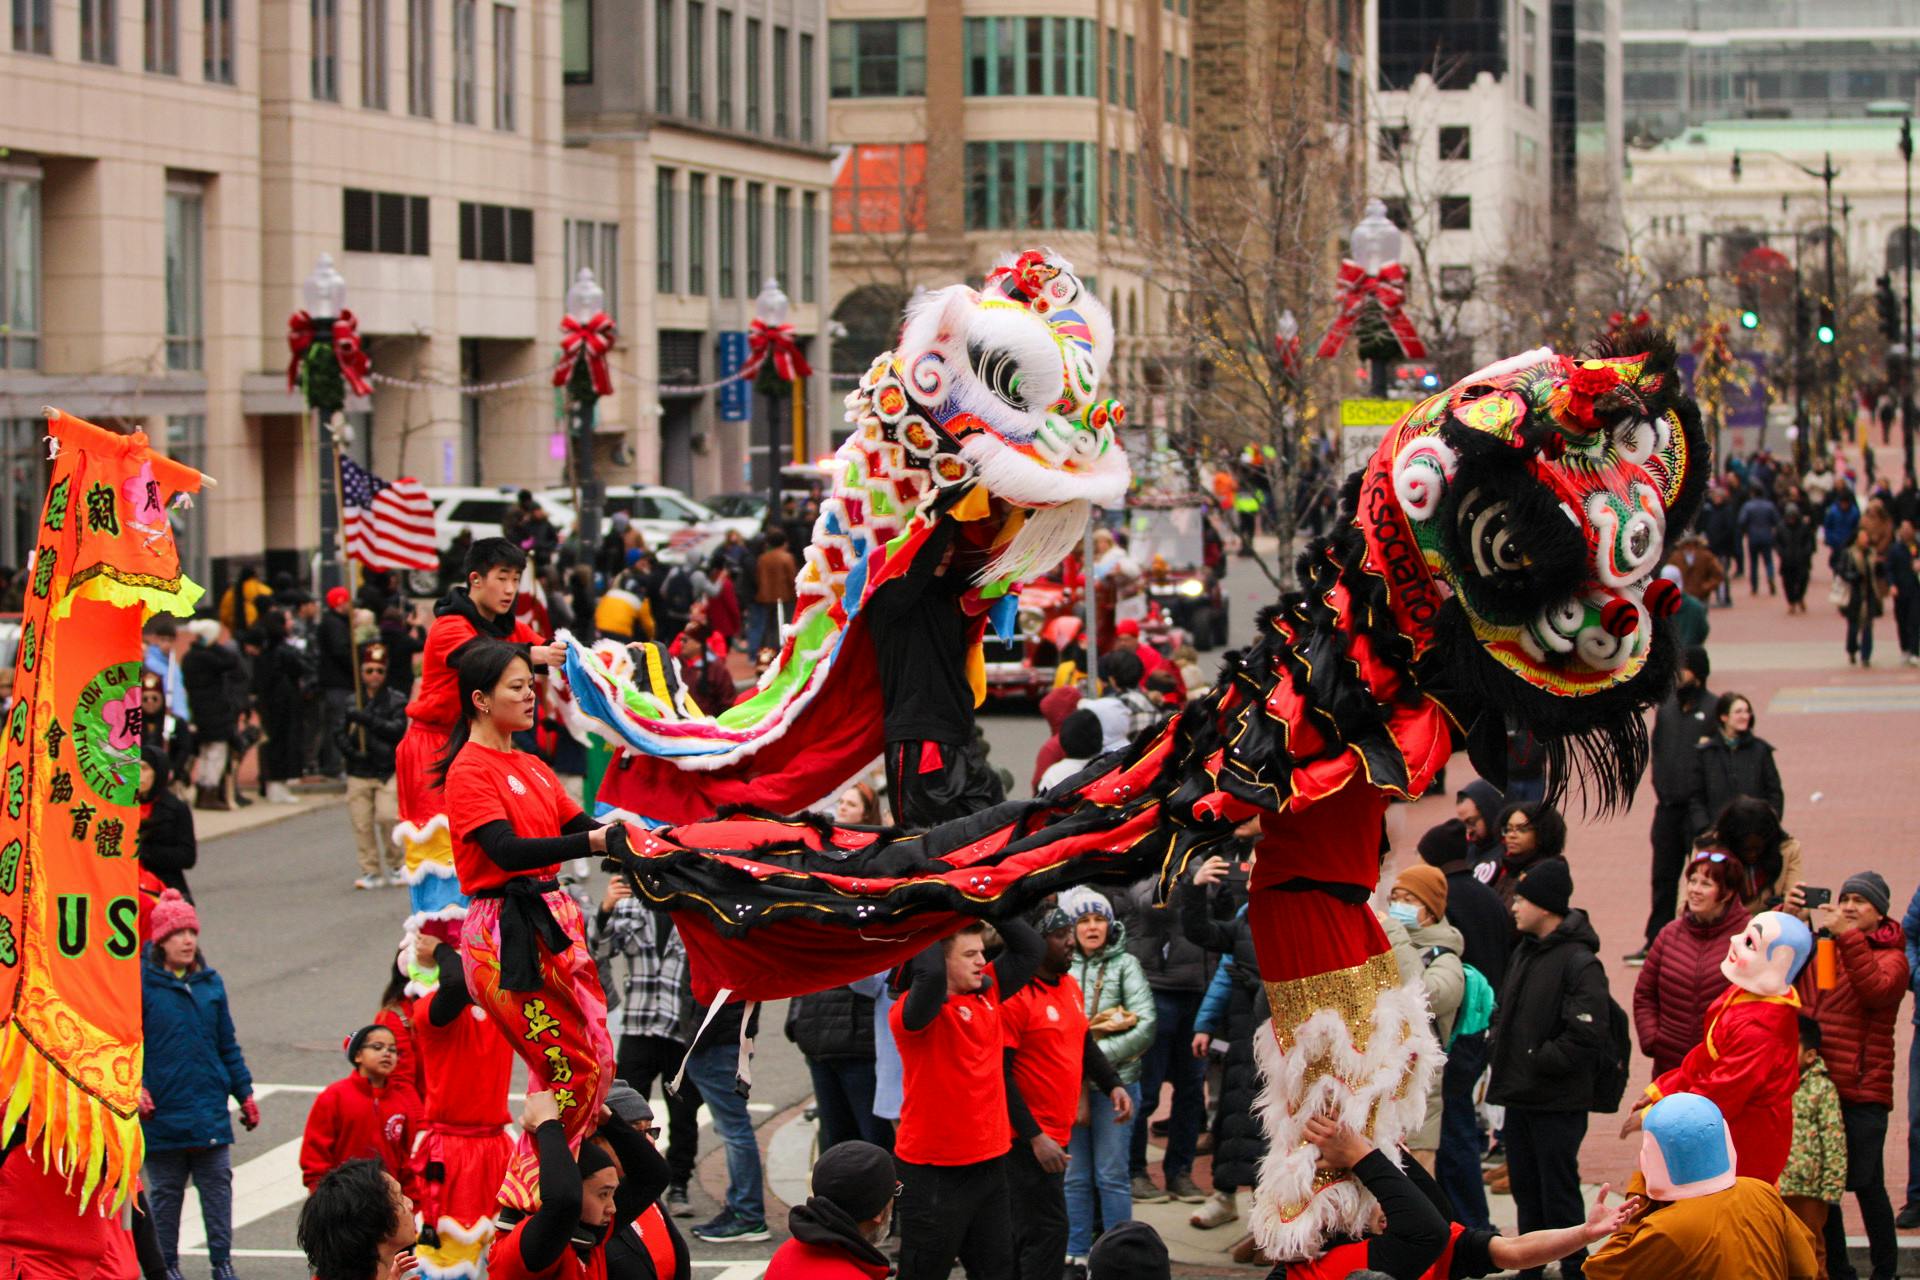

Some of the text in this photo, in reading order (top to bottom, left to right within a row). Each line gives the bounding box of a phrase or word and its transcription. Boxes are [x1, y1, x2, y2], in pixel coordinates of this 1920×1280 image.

[78, 681, 104, 714] JOW
[104, 666, 129, 687] GA
[73, 721, 117, 800] ATHLETIC
